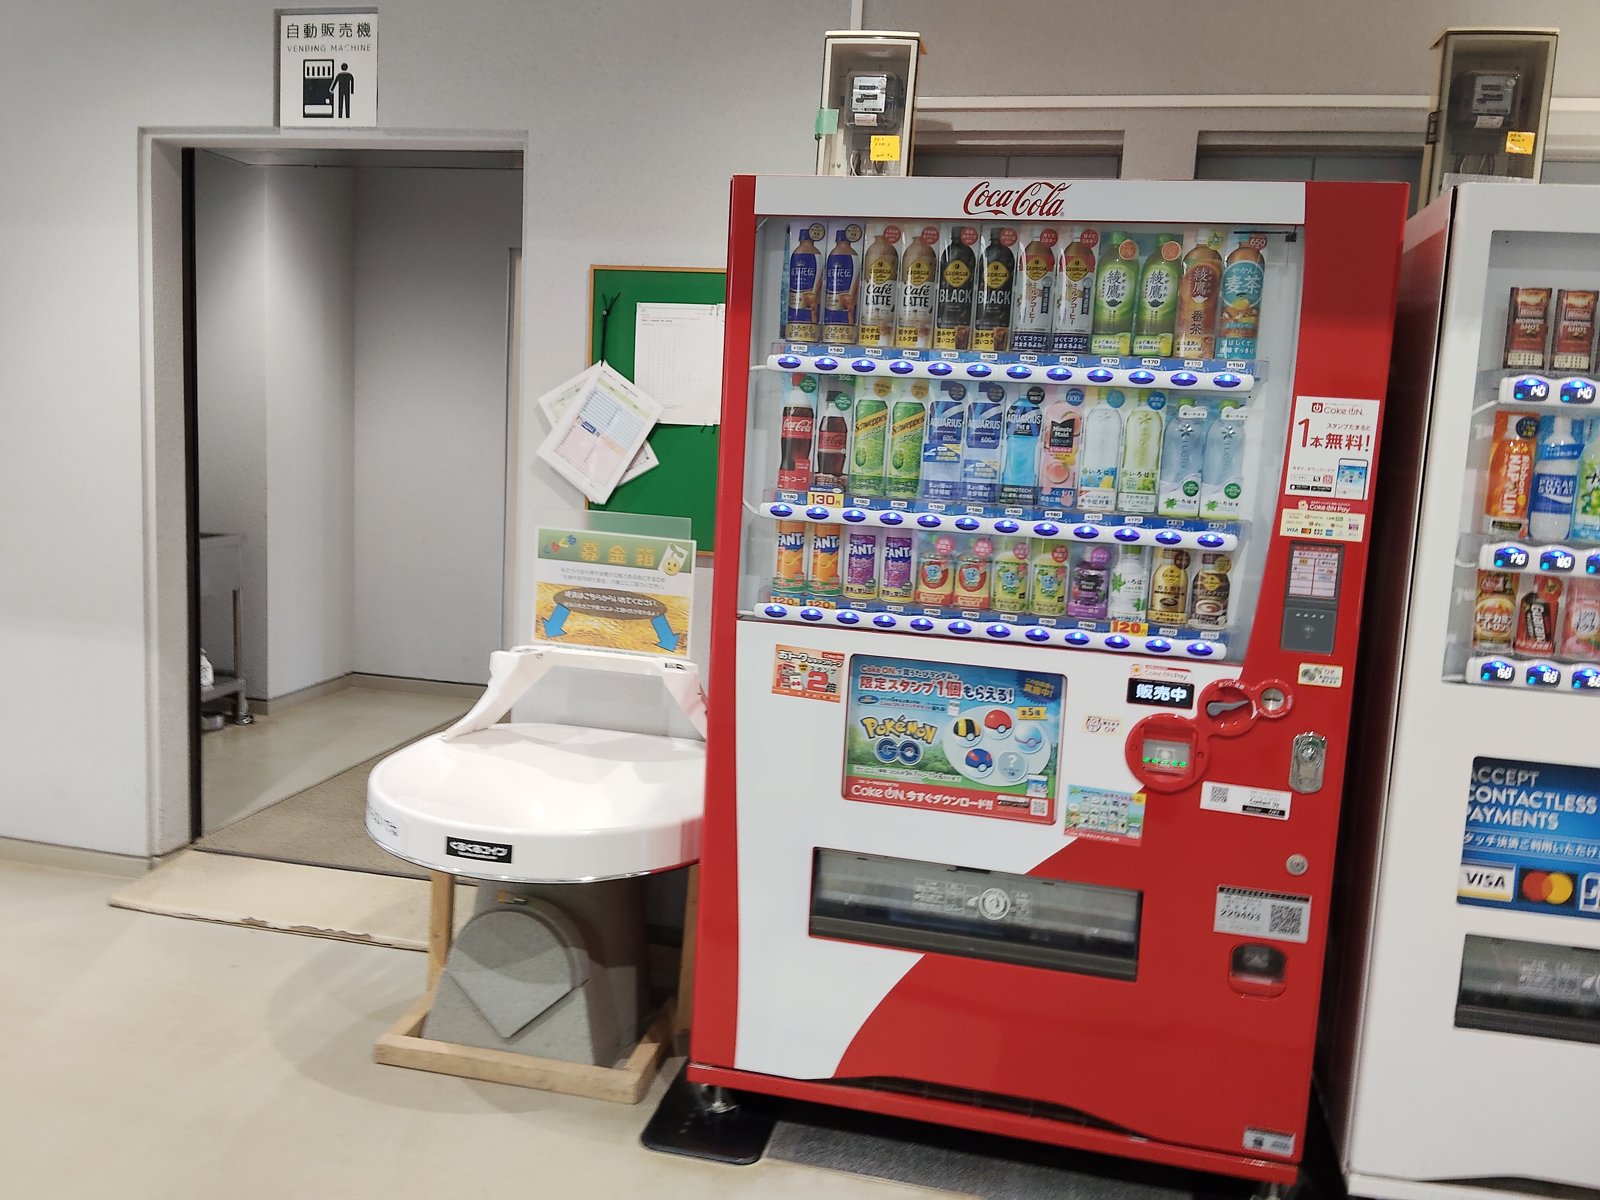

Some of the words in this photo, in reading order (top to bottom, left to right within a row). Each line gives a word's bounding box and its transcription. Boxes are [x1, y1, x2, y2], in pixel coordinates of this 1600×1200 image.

[287, 22, 371, 39] 自動販売機
[287, 44, 327, 53] VENDING
[330, 43, 371, 53] MACHINE
[963, 181, 1072, 217] Coca-Cola
[867, 284, 892, 296] Café
[1106, 270, 1121, 298] 綾鷹
[1149, 270, 1163, 299] 綾鷹
[1225, 275, 1260, 294] 麦茶
[904, 285, 930, 297] Café
[939, 289, 972, 303] BLACK
[978, 290, 1011, 305] BLACK
[866, 295, 891, 306] LATTE
[903, 297, 930, 307] LATTE
[1324, 407, 1346, 415] Coke
[931, 418, 962, 428] AQUARIUS
[968, 419, 1000, 430] AQUARIUS
[1007, 413, 1041, 424] AQUARIUS
[1327, 423, 1371, 431] スタンプたまると
[1298, 418, 1370, 452] 1本無料!
[1136, 684, 1187, 702] 販売中
[874, 738, 923, 765] GO
[851, 785, 884, 797] Coke
[1466, 872, 1506, 889] VISA
